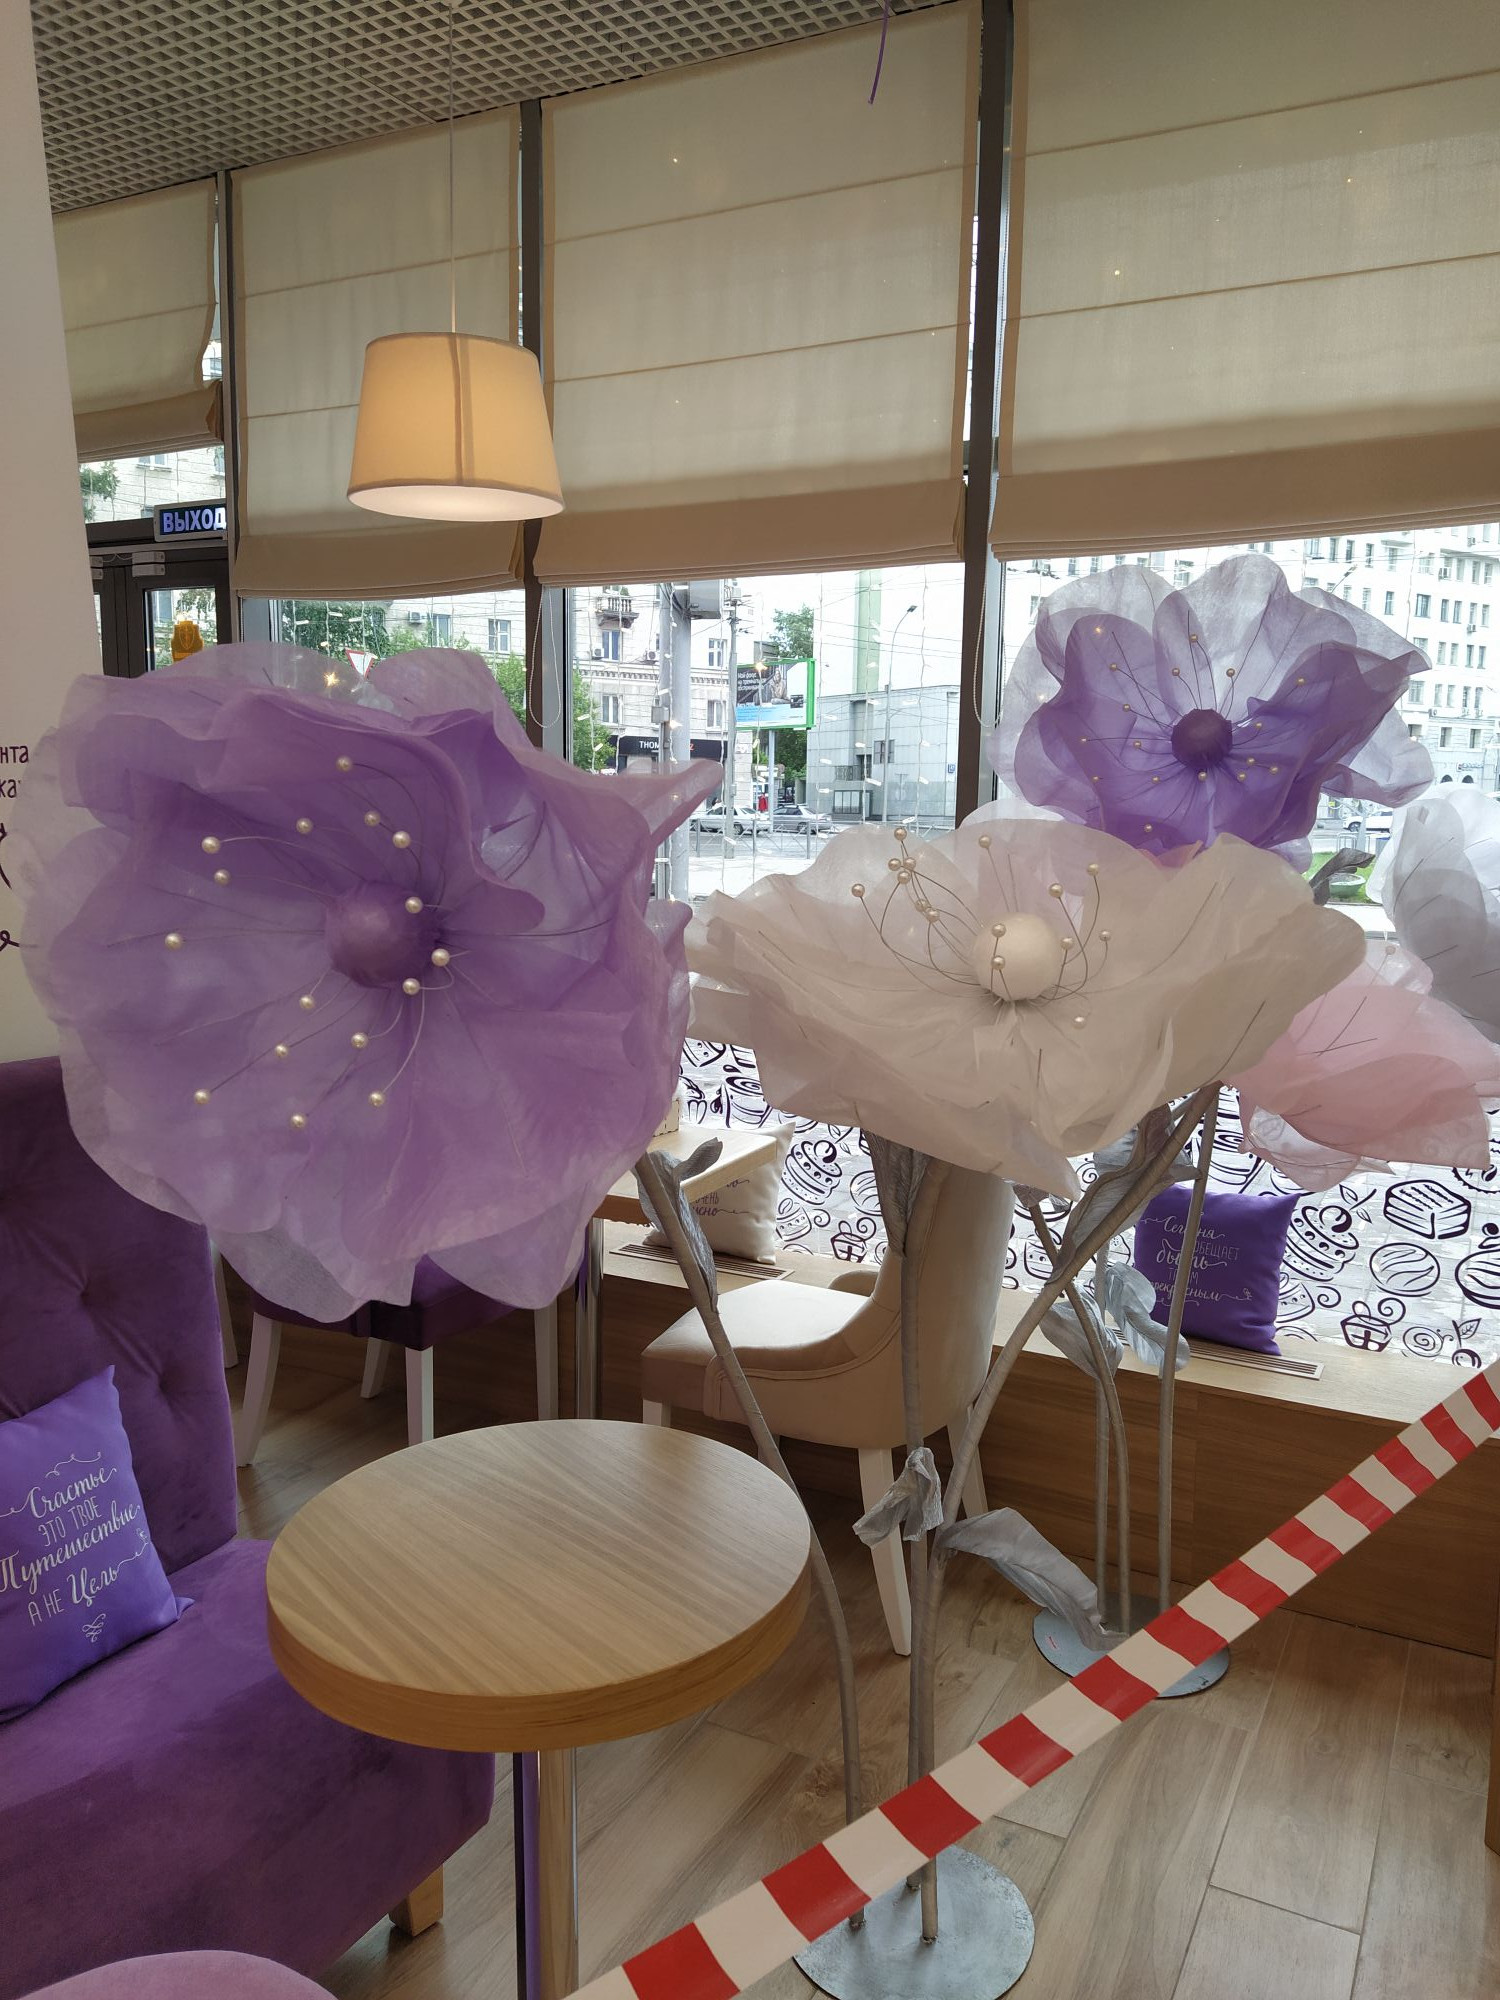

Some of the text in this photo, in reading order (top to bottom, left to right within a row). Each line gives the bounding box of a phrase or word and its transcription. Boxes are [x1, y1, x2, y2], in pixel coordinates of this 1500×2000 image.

[163, 507, 227, 533] ВЫХОД
[28, 1467, 118, 1518] Счастье
[38, 1496, 102, 1547] ЭТО ТВОЕ
[28, 1567, 119, 1627] А НЕ Цель
